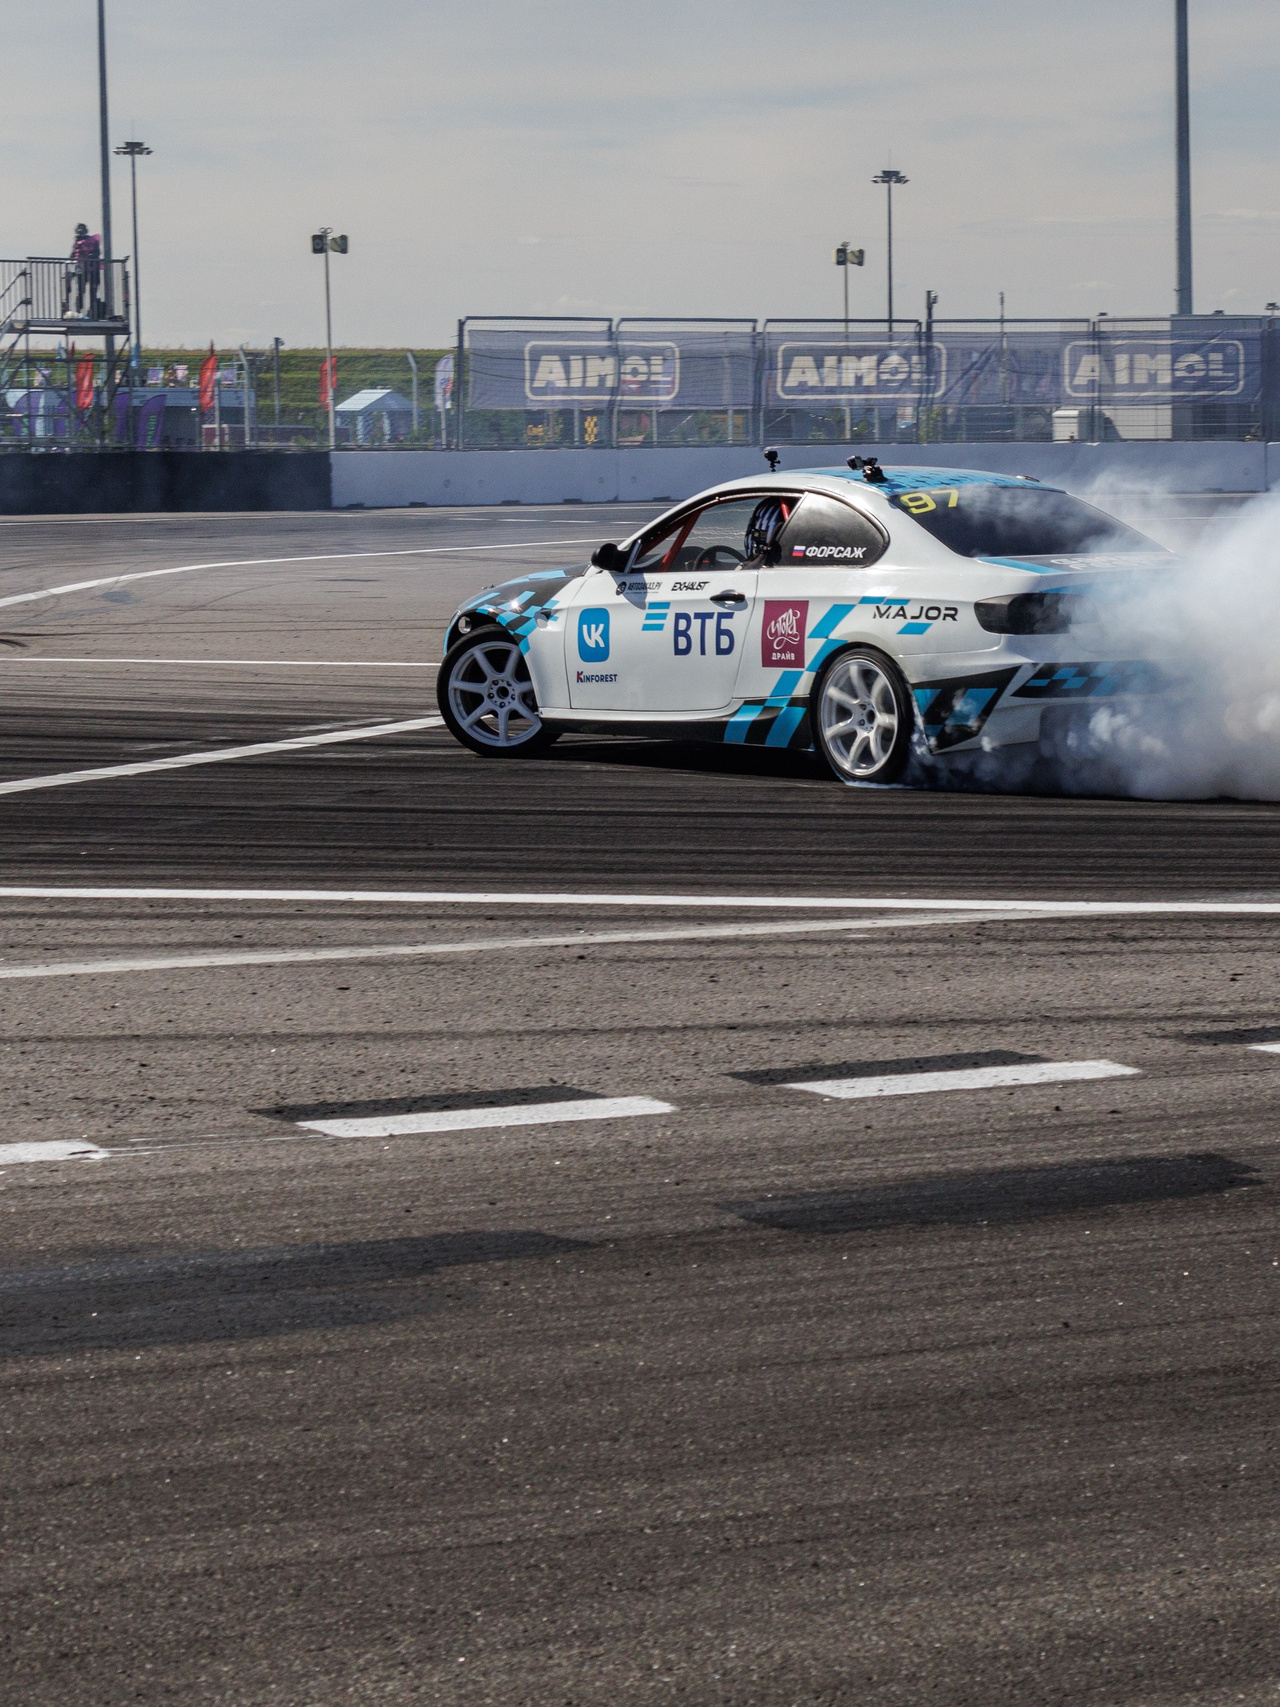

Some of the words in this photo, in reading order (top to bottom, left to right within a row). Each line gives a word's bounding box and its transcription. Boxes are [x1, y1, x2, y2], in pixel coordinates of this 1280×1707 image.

[531, 355, 673, 388] AIMOL
[784, 355, 936, 387] AIMOL
[1072, 352, 1236, 385] AIMOL
[899, 488, 959, 514] 97
[805, 545, 867, 559] ФОРСАЖ
[671, 581, 711, 592] EXHAUST
[872, 605, 959, 622] MAJOR
[582, 623, 606, 648] VK
[673, 612, 736, 656] ВТБ
[771, 651, 795, 661] ДРАЙВ
